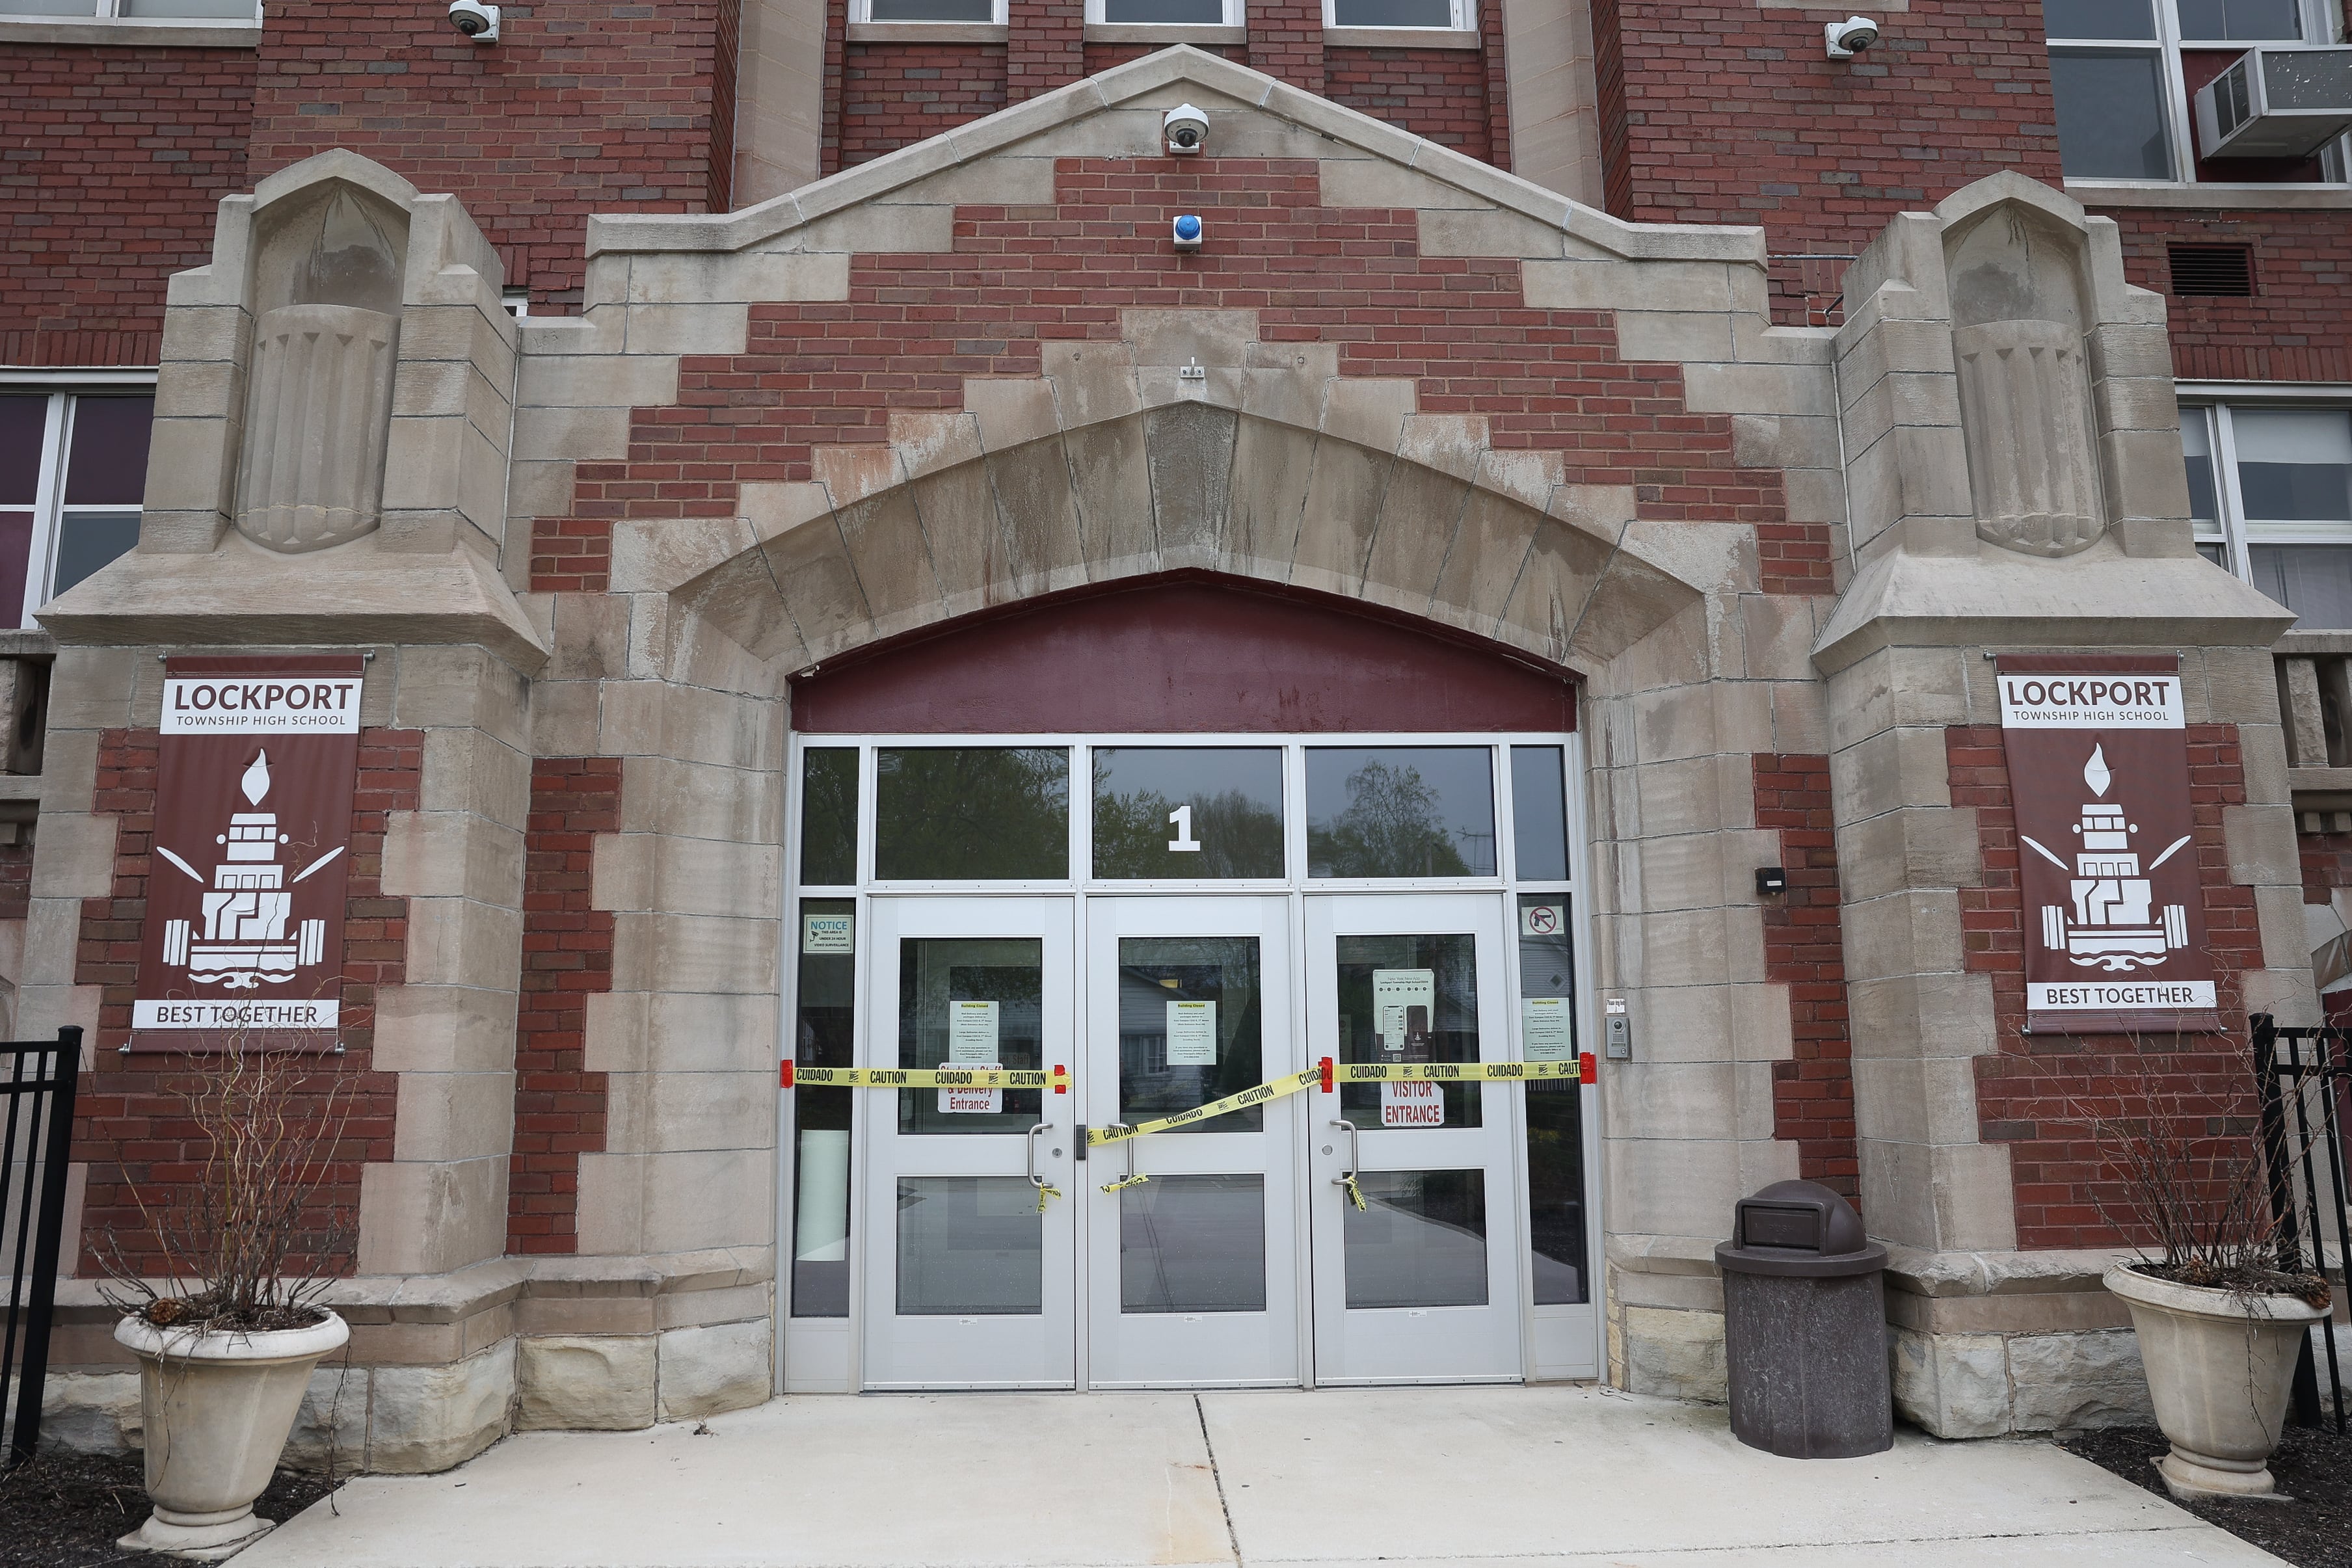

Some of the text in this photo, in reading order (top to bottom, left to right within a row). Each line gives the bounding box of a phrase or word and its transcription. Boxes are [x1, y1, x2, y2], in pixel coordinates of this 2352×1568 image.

[175, 684, 353, 710] LOCKPORT
[2007, 681, 2169, 706] LOCKPORT
[176, 715, 346, 725] TOWNSHIP HIGH SCHOOL
[2014, 711, 2169, 721] TOWNSHIP HIGH SCHOOL
[1169, 806, 1200, 851] 1
[811, 921, 847, 930] NOTICE
[2046, 987, 2194, 1004] BEST TOGETHER
[156, 1006, 317, 1022] BEST TOGETHER
[797, 1069, 833, 1082] CUIDADO
[870, 1070, 907, 1083] CAUTION
[935, 1071, 972, 1084] CUIDADO
[1009, 1072, 1046, 1085] CAUTION
[1350, 1065, 1387, 1078] CUIDADO
[1424, 1065, 1460, 1078] CAUTION
[1488, 1064, 1523, 1077] CUIDADO
[1558, 1062, 1581, 1075] CAUTI
[1392, 1081, 1432, 1098] VISITOR
[950, 1097, 990, 1110] Entrance
[1103, 1123, 1139, 1140] CAUTION
[1166, 1109, 1203, 1124] CUIDADO
[1237, 1084, 1275, 1105] CAUTION
[1386, 1105, 1440, 1123] ENTRANCE
